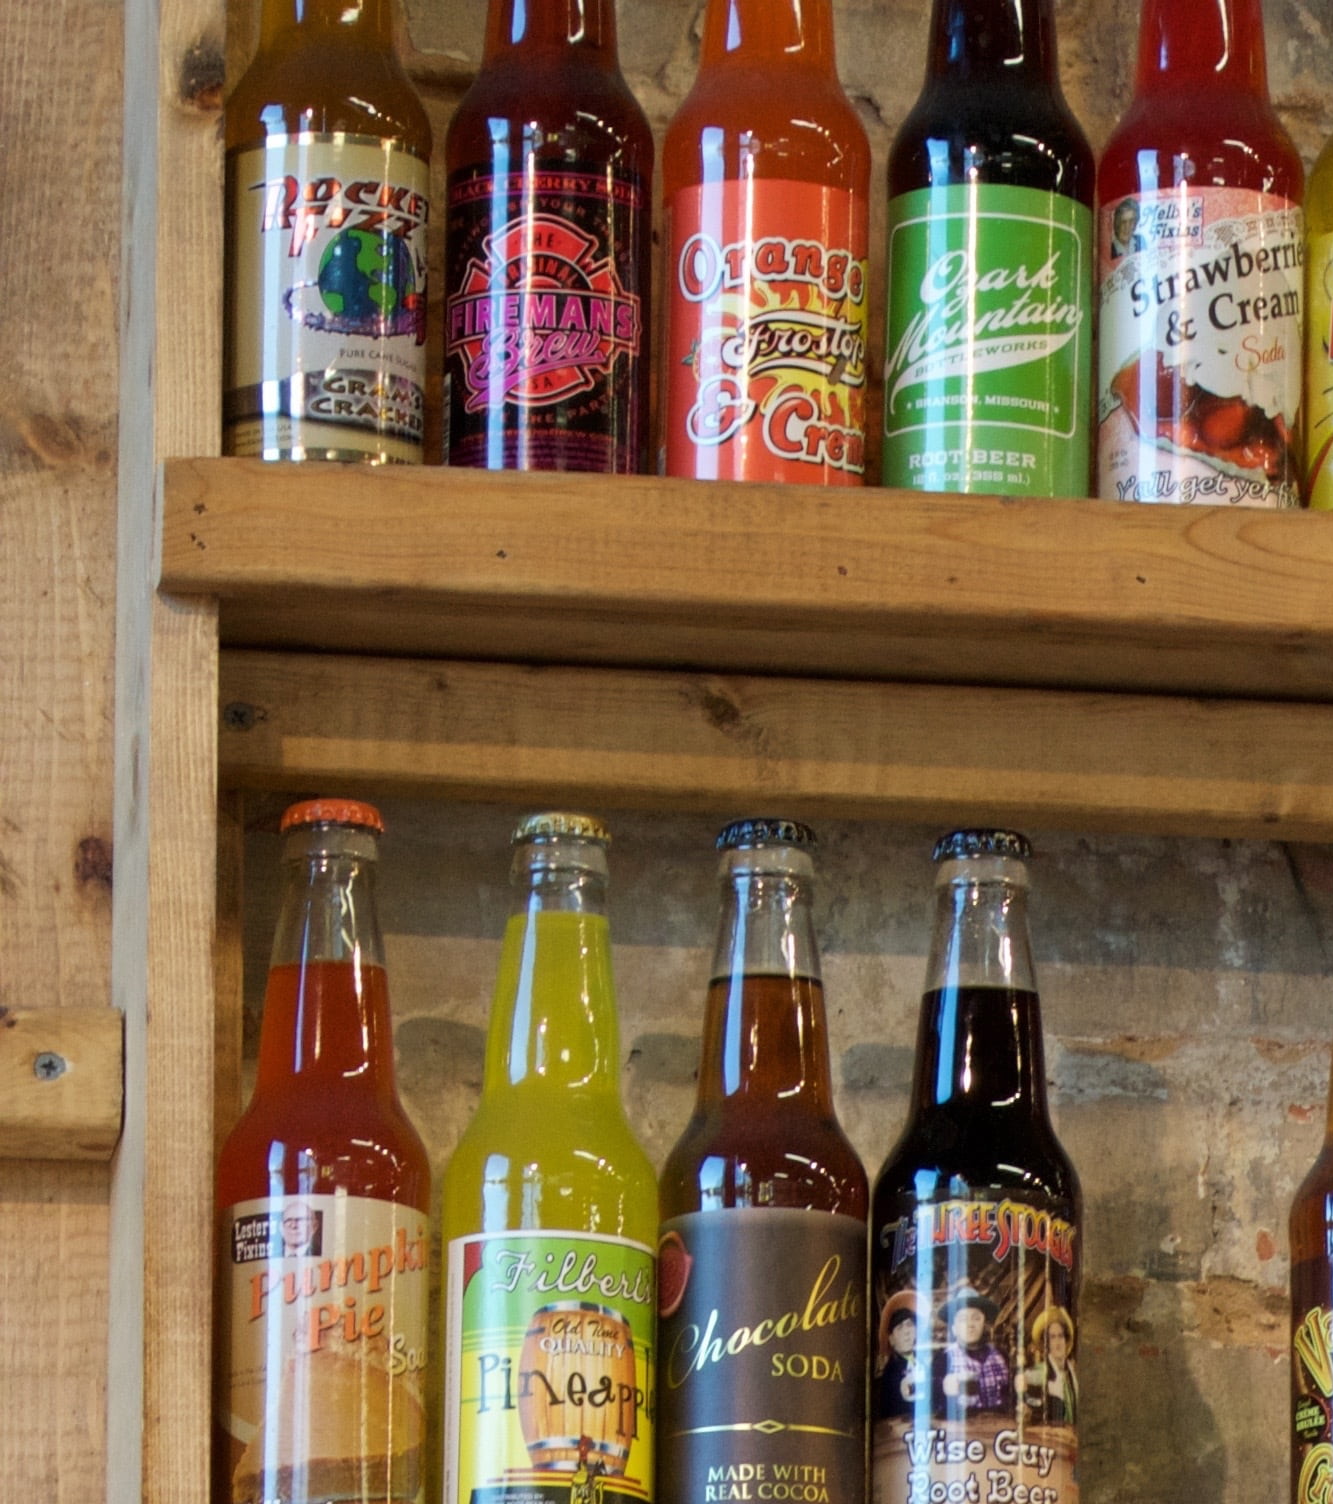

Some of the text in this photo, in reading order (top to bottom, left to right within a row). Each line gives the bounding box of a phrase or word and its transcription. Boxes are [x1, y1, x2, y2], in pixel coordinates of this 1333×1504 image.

[678, 235, 867, 305] Orange
[920, 248, 1059, 320] Ozark
[451, 295, 637, 333] FIREMANS
[890, 292, 1083, 362] Mountain
[909, 452, 1036, 469] ROOT BEER
[905, 1431, 1054, 1473] Wise Guy
[705, 1483, 828, 1503] REAL COCOA
[707, 1464, 828, 1483] MADE WITH
